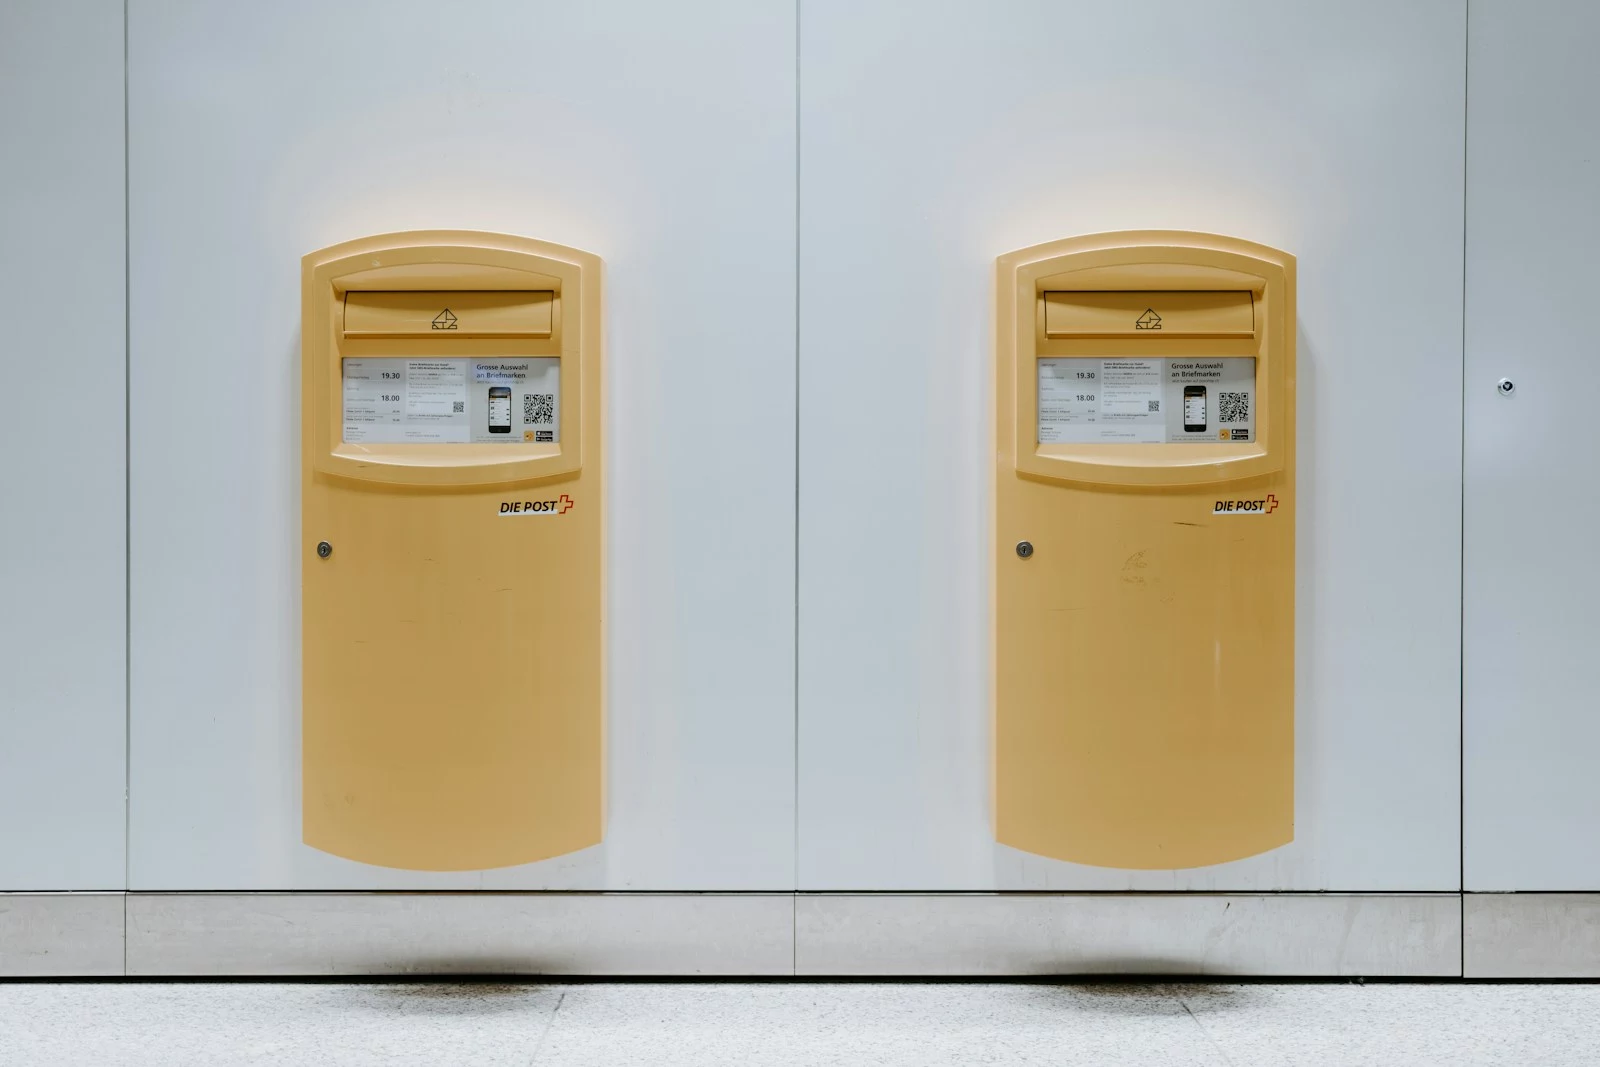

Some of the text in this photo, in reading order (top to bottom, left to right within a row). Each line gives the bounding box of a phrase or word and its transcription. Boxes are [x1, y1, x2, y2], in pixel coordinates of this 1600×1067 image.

[500, 501, 558, 513] DIE POST
[1215, 500, 1266, 512] DIE POST
